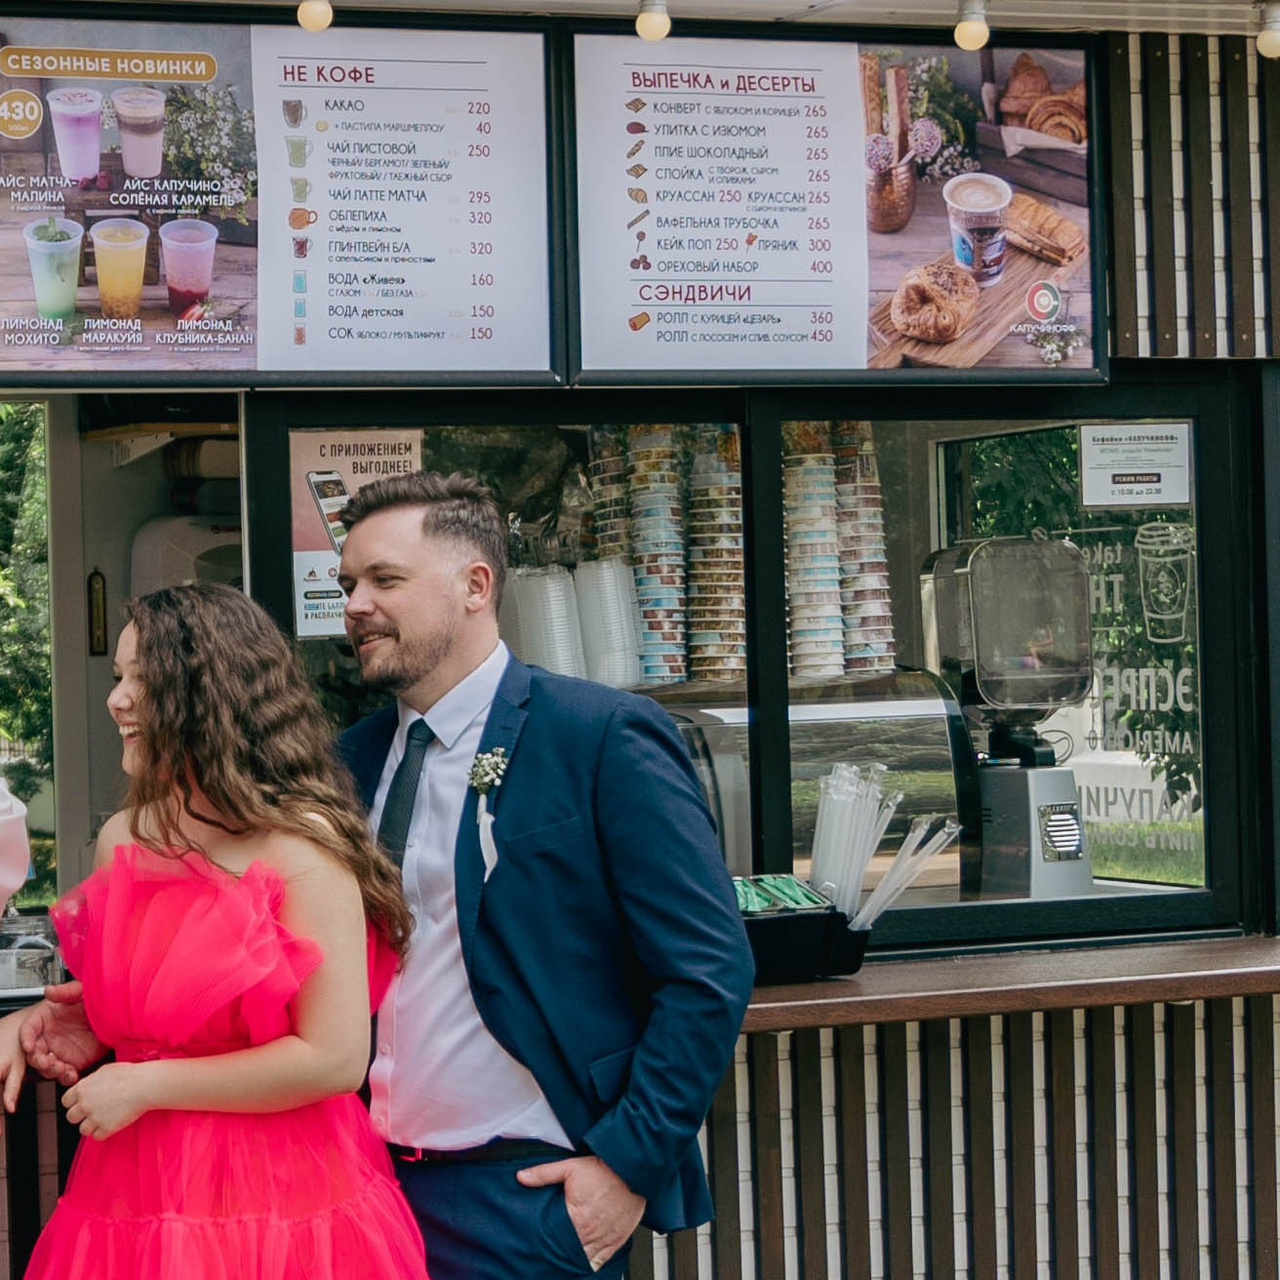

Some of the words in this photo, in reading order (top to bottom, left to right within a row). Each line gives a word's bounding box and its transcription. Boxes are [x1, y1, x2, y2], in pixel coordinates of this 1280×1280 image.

[8, 55, 110, 72] СЕЗОННЫЕ
[117, 58, 206, 75] НОВИНКИ
[284, 66, 307, 82] НЕ
[317, 66, 374, 83] КОФЕ
[632, 72, 714, 90] ВЫПЕЧКА
[721, 80, 729, 90] и
[736, 75, 815, 93] ДЕСЕРТЫ
[325, 100, 364, 111] КАКАО
[468, 102, 490, 114] 220
[653, 103, 701, 113] КОНВЕРТ
[805, 106, 826, 117] 265
[341, 123, 382, 131] ПАСТИЛА
[384, 124, 444, 133] МАРШМЕЛЛОУ
[476, 122, 491, 134] 40
[654, 125, 697, 135] УЛИТКА
[701, 126, 711, 136] С
[713, 126, 766, 137] ИЗЮМОМ
[806, 127, 828, 138] 265
[327, 140, 350, 154] ЧАЙ
[353, 142, 416, 154] ЛИСТОВОЙ
[468, 145, 490, 157] 250
[655, 147, 683, 157] ПЛИЕ
[687, 146, 768, 159] ШОКОЛАДНЫЙ
[806, 148, 828, 160] 265
[656, 166, 703, 179] СЛОЙКА
[808, 170, 830, 182] 265
[30, 177, 77, 188] МАТЧА-
[123, 177, 151, 190] АЙС
[155, 180, 221, 192] КАПУЧИНО
[11, 190, 64, 202] МАЛИНА
[110, 192, 168, 205] СОЛЁНАЯ
[172, 194, 235, 207] КАРАМЕЛЬ
[329, 188, 351, 200] ЧАЙ
[353, 190, 385, 201] ЛАТТЕ
[388, 191, 427, 202] МАТЧА
[469, 192, 490, 203] 295
[656, 191, 714, 202] КРУАССАН
[720, 191, 741, 202] 250
[748, 192, 805, 203] КРУАССАН
[808, 192, 830, 203] 265
[329, 210, 387, 221] ОБЛЕПИХА
[469, 212, 492, 224] 320
[657, 217, 719, 228] ВАФЕЛЬНАЯ
[724, 218, 779, 229] ТРУБОЧКА
[808, 218, 829, 229] 265
[329, 240, 389, 252] ГЛИНТВЕЙН
[392, 242, 410, 253] Б/А
[470, 243, 492, 254] 320
[657, 237, 684, 250] КЕЙК
[688, 239, 711, 250] ПОП
[716, 239, 738, 250] 250
[758, 240, 798, 250] ПРЯНИК
[809, 240, 831, 251] 300
[658, 259, 719, 272] ОРЕХОВЫЙ
[723, 261, 759, 272] НАБОР
[811, 261, 832, 273] 400
[329, 274, 359, 286] ВОДА
[471, 274, 493, 286] 160
[639, 285, 751, 304] СЭНДВИЧИ
[329, 305, 359, 317] ВОДА
[362, 308, 404, 317] детская
[472, 305, 494, 317] 150
[657, 313, 688, 323] РОЛЛ
[811, 312, 833, 323] 360
[1, 319, 63, 331] ЛИМОНАД
[84, 319, 141, 331] ЛИМОНАД
[177, 320, 232, 332] ЛИМОНАД
[5, 333, 59, 345] МОХИТО
[83, 330, 142, 343] МАРАКУЙЯ
[156, 334, 253, 344] КЛУБНИКА-БАНАН
[329, 328, 353, 339] СОК
[470, 328, 492, 339] 150
[657, 331, 688, 342] РОЛЛ
[811, 330, 833, 342] 450
[320, 445, 325, 457] С
[331, 443, 412, 457] ПРИЛОЖЕНИЕМ
[353, 460, 412, 474] ВЫГОДНЕЕ!
